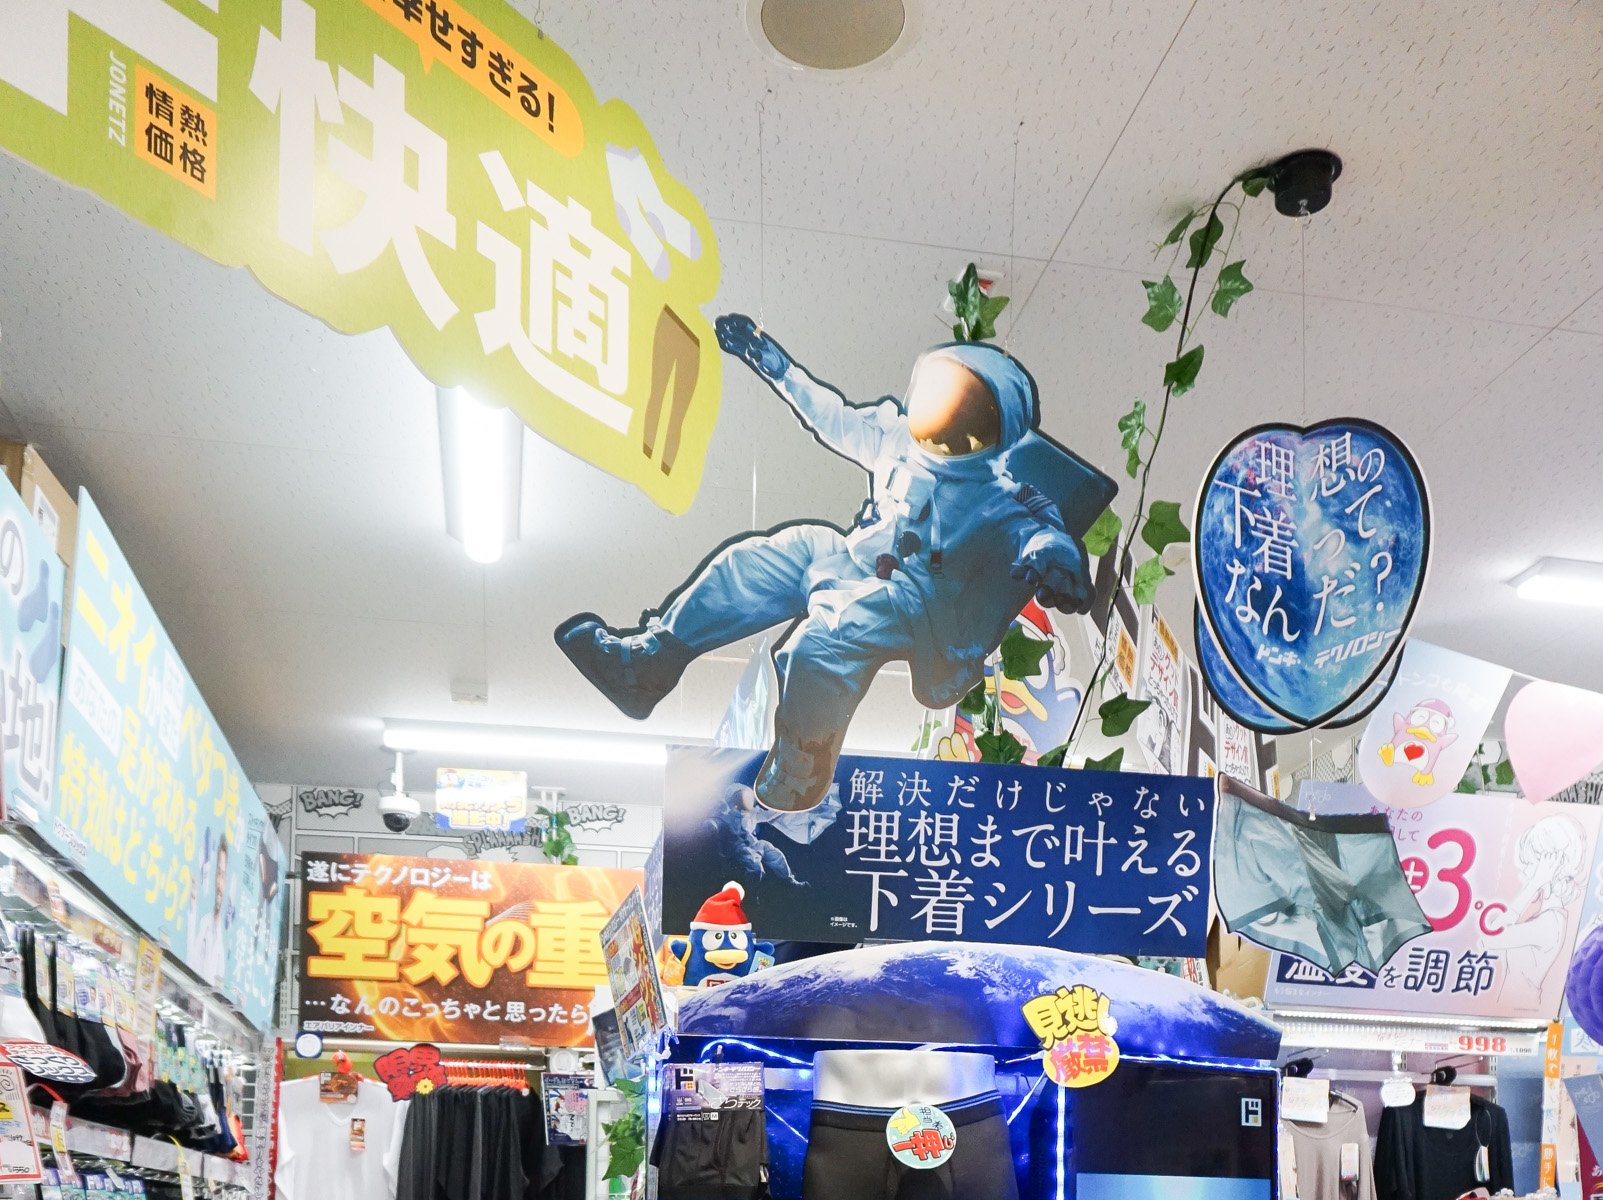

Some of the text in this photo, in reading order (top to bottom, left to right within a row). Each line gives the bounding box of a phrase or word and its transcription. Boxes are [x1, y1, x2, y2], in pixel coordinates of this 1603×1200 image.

[1255, 432, 1386, 501] 理想の
[299, 789, 364, 813] BANG!
[848, 766, 1206, 820] 解決だけじゃない
[566, 803, 626, 826] BANG!
[843, 807, 1203, 878] 理想まで叶える
[307, 860, 492, 891] 遂にテクノロジーは
[845, 868, 1200, 938] 下着シリーズ
[1458, 1035, 1506, 1053] 998
